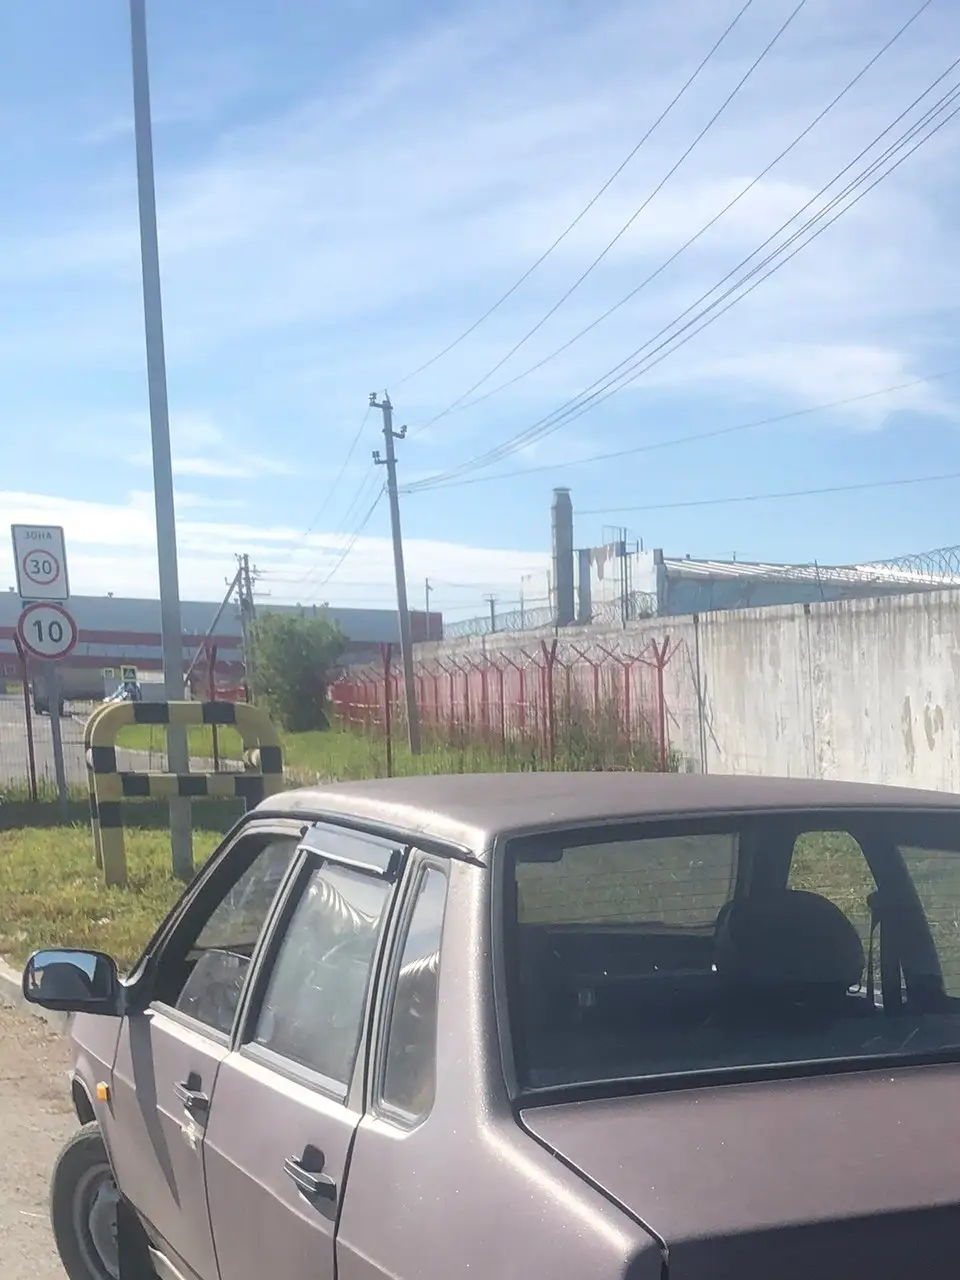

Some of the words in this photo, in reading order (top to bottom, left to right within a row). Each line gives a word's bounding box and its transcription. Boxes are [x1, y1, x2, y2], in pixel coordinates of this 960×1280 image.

[24, 531, 52, 540] ЗОНА
[30, 559, 52, 575] 30
[32, 620, 63, 643] 10
